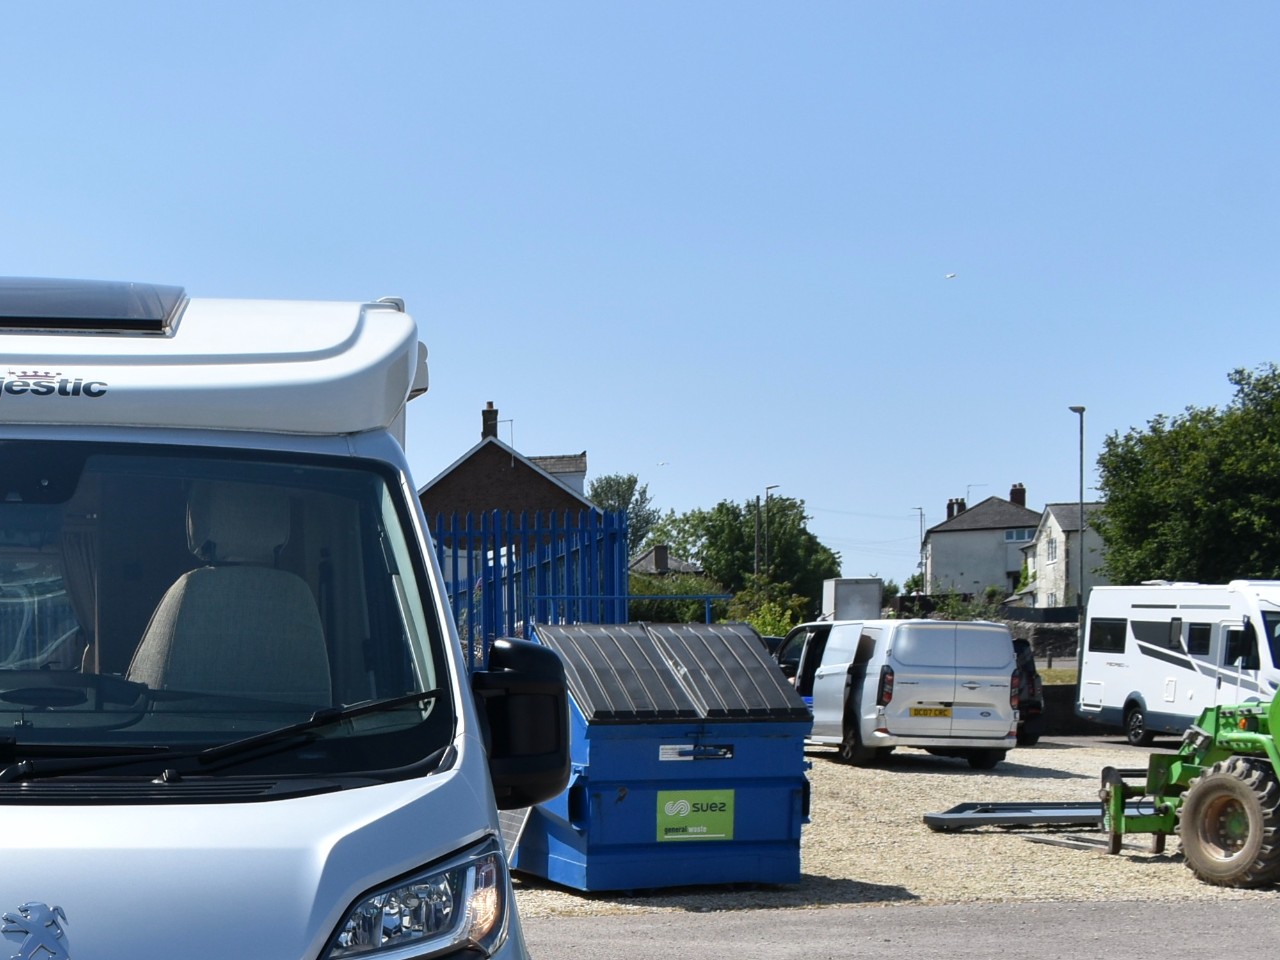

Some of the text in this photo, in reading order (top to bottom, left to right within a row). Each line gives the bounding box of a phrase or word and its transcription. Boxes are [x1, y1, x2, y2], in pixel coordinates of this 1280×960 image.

[692, 802, 727, 813] suez
[664, 825, 707, 835] general waste
